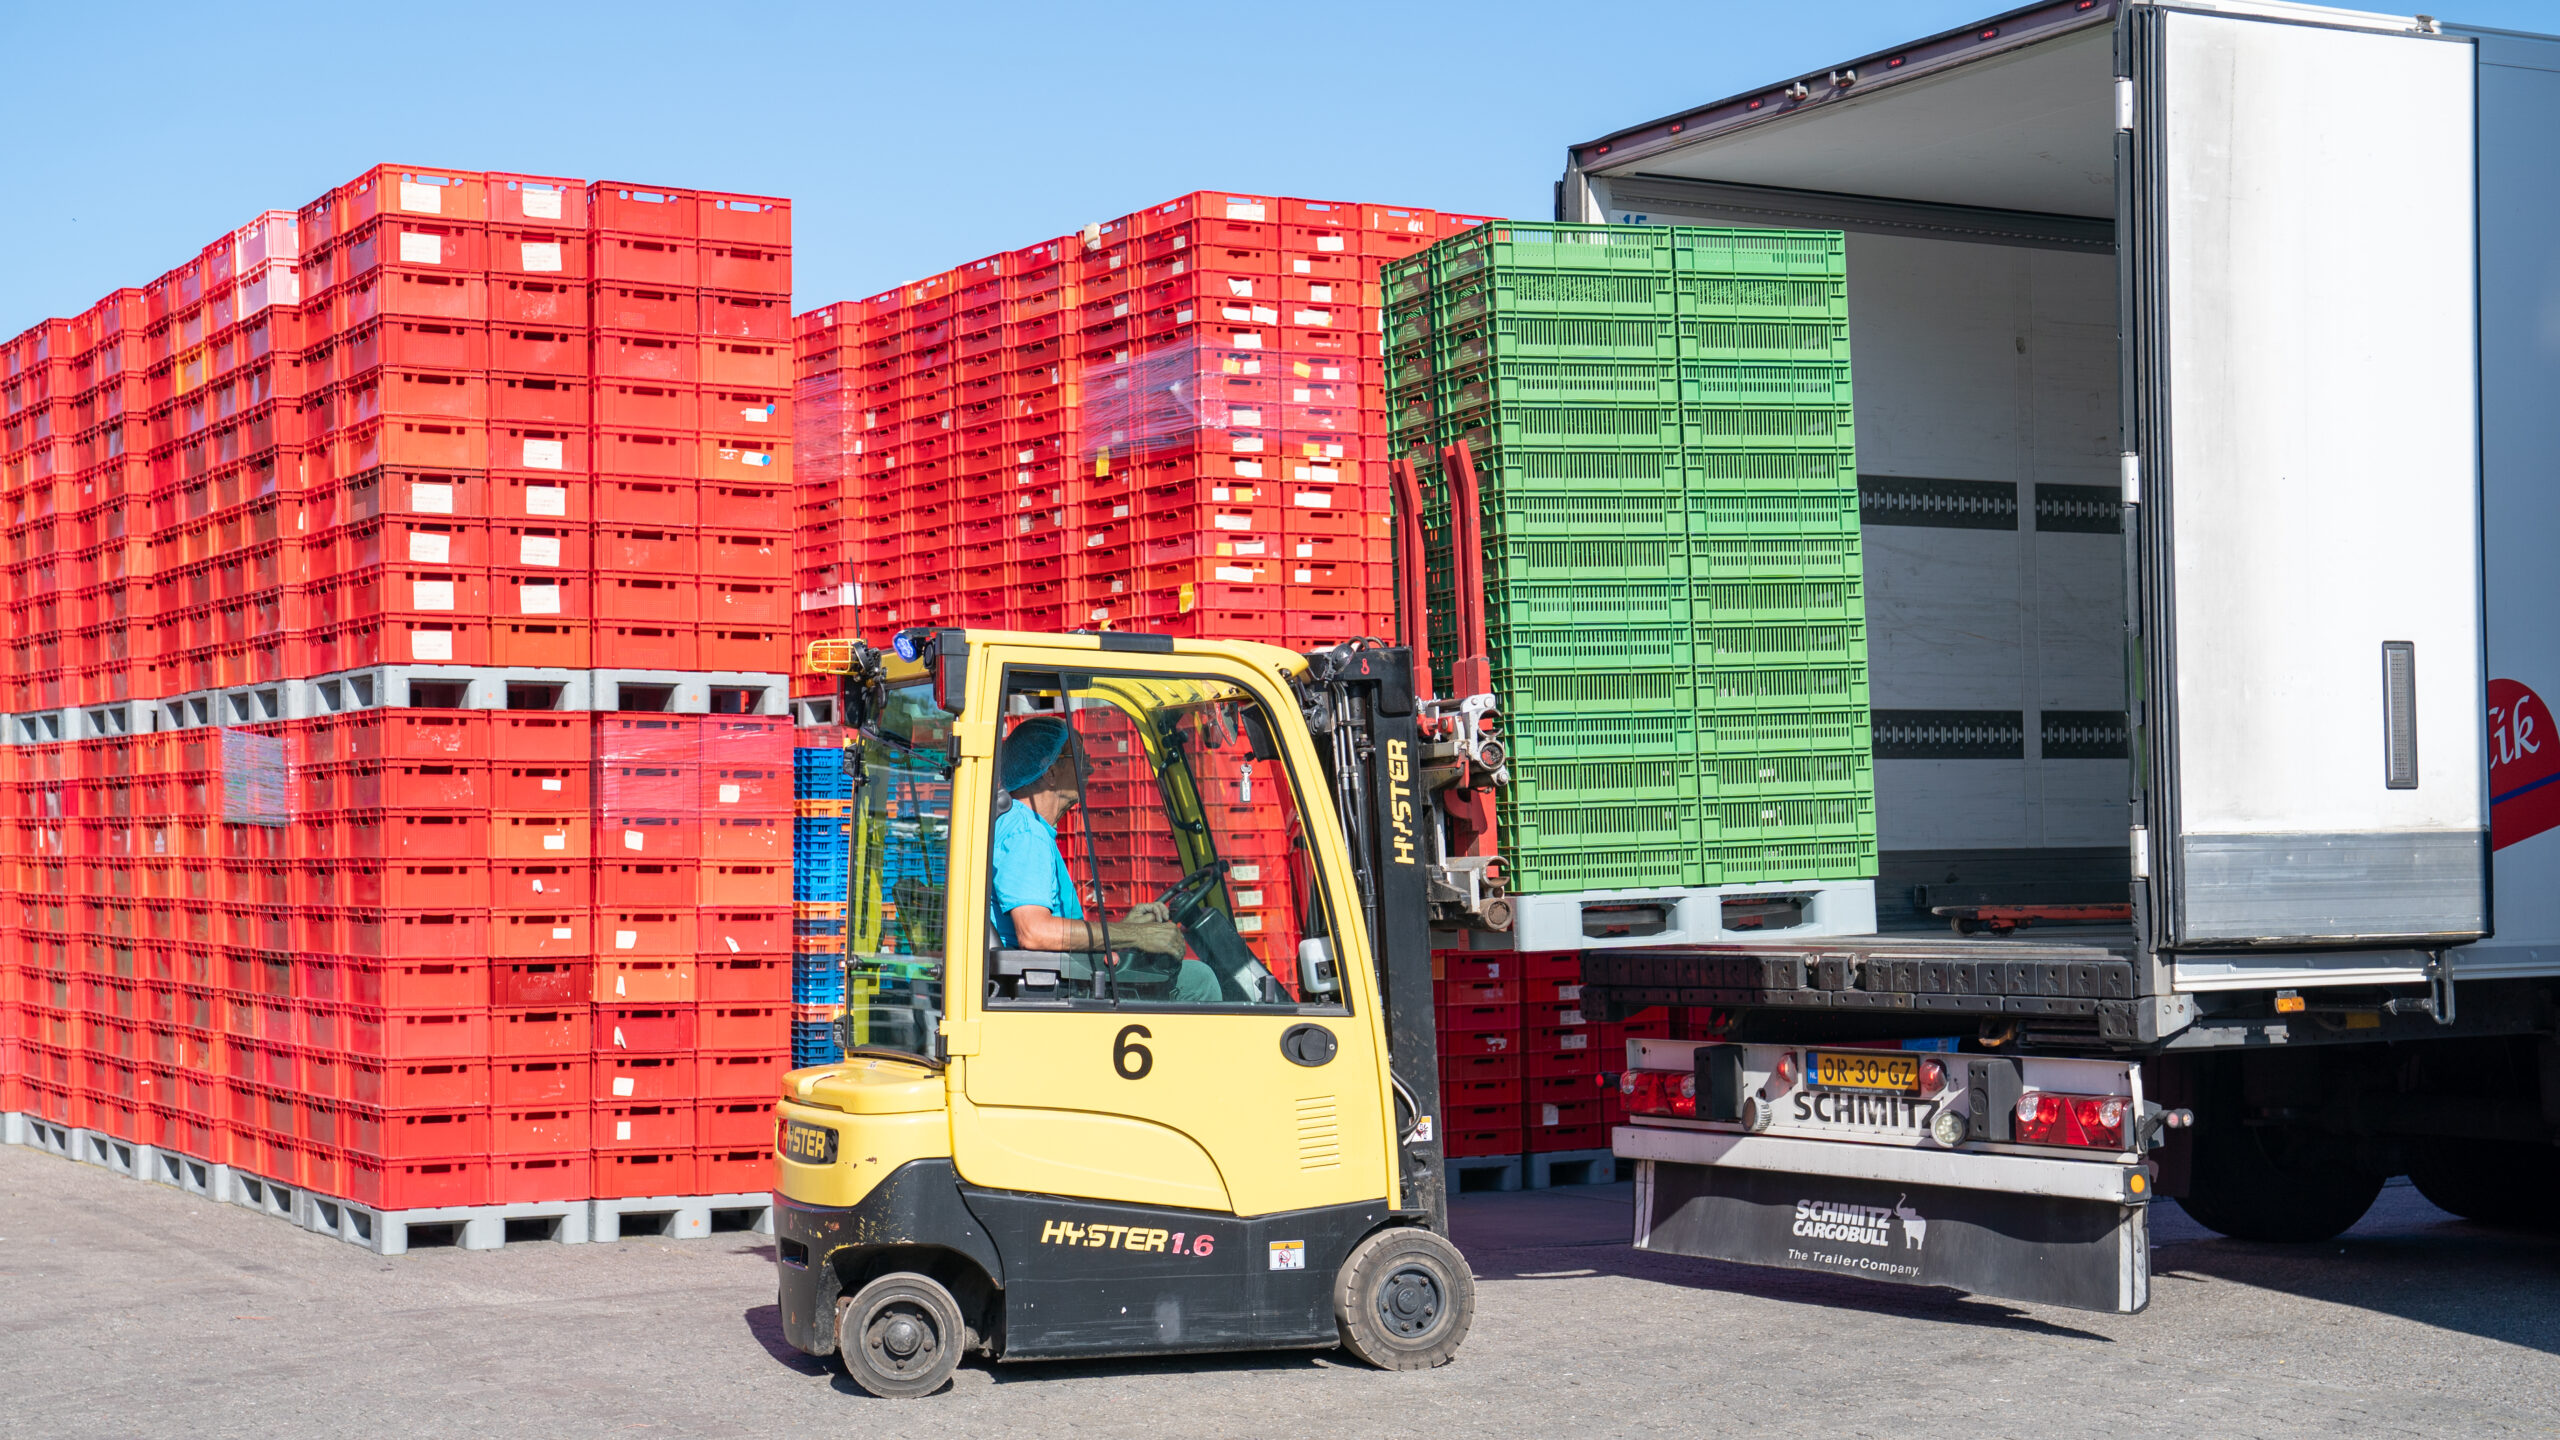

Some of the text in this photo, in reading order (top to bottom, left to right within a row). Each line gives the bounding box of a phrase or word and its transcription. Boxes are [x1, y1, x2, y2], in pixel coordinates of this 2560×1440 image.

[2488, 695, 2541, 770] ik
[1387, 738, 1415, 865] HYSTER
[1113, 1024, 1153, 1080] 6
[1809, 1071, 1817, 1080] NL
[1794, 1091, 1941, 1129] SCHMITZ
[1795, 1199, 1892, 1229] SCHMITZ
[1041, 1220, 1215, 1257] HYSTER 1.6
[1792, 1220, 1889, 1247] CARGOBULL
[1788, 1248, 1920, 1278] The Trailer Company.
